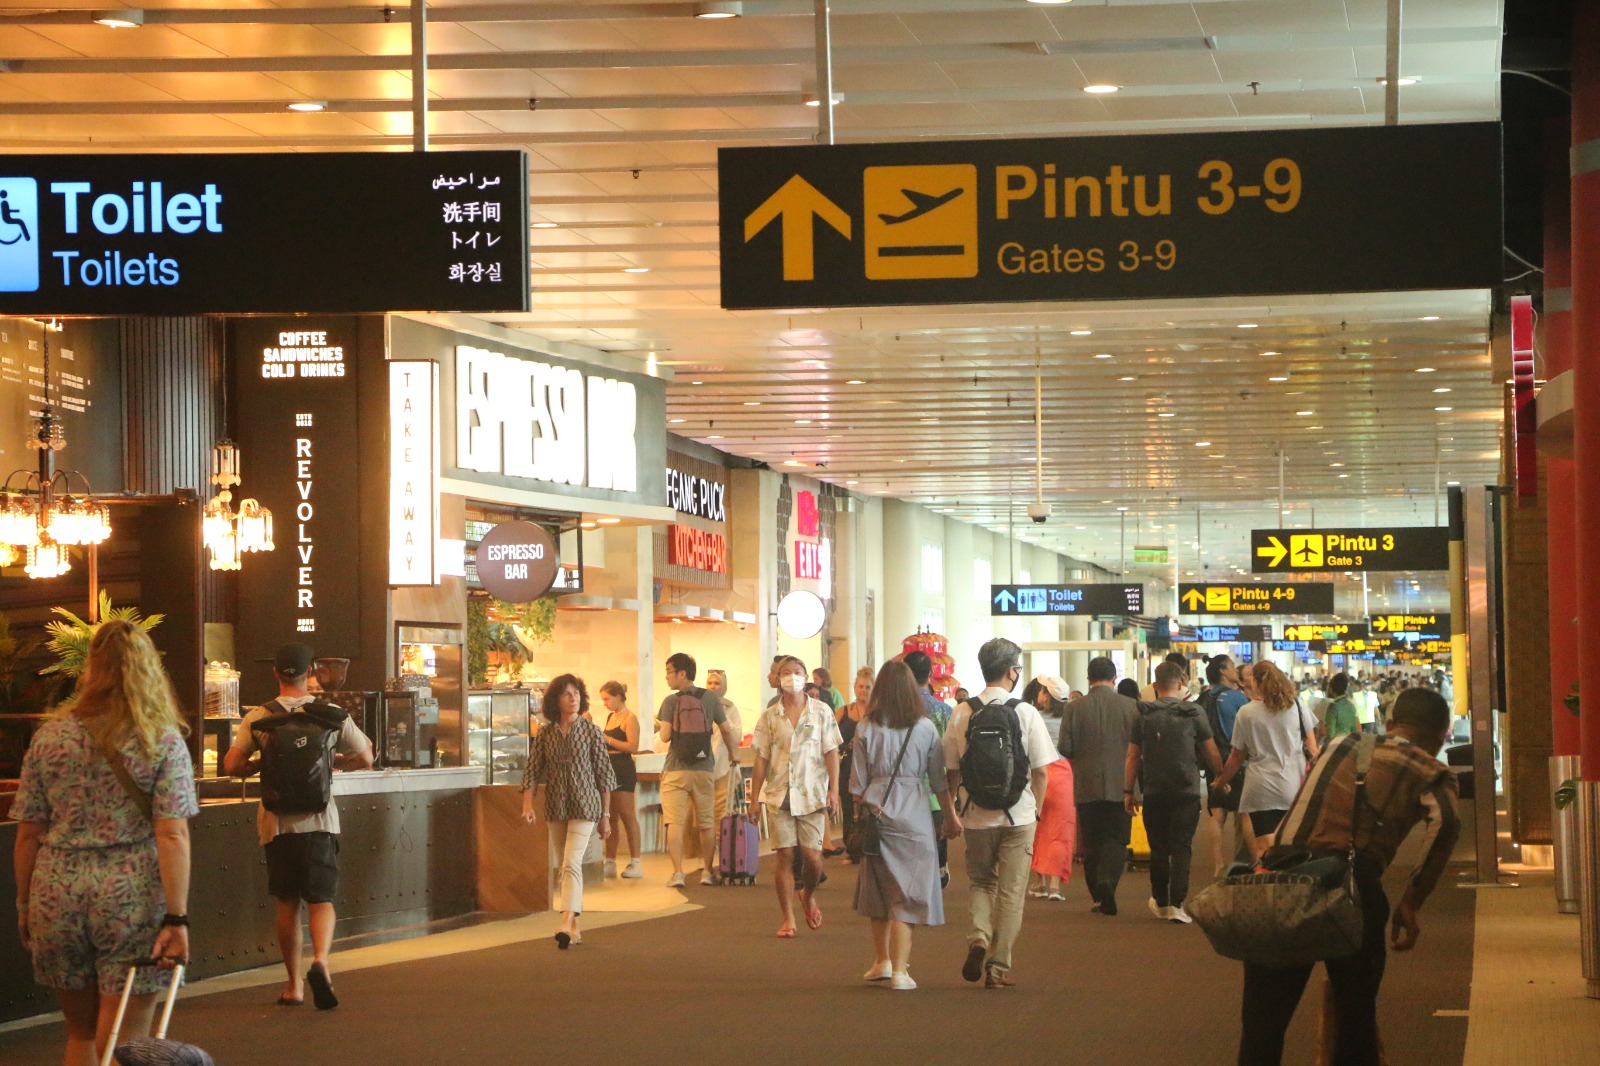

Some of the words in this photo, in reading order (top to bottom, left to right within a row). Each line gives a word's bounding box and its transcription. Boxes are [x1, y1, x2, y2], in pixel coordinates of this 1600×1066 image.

[432, 172, 501, 190] مراحيض
[996, 163, 1171, 220] Pintu
[1197, 158, 1302, 215] 3-9
[51, 181, 223, 235] Toilet
[442, 201, 501, 223] 洗手间
[451, 231, 502, 249] トイレ
[997, 240, 1105, 276] Gates
[1118, 239, 1177, 272] 3-9
[52, 250, 180, 287] Toilets
[448, 262, 502, 283] 화장실
[279, 331, 327, 346] COFFEE
[263, 347, 343, 362] SANDWICHES
[262, 363, 295, 378] COLD
[300, 362, 345, 377] DRINKS
[403, 372, 412, 463] TAKE
[700, 478, 725, 522] PUCK
[296, 438, 313, 608] REVOLVER
[403, 481, 415, 571] AWAY
[1326, 534, 1377, 551] Pintu
[1382, 534, 1395, 551] 3
[488, 543, 544, 560] ESPRESSO
[1327, 556, 1352, 566] Gate
[1355, 556, 1362, 566] 3
[504, 564, 528, 579] BAR
[1049, 589, 1083, 601] Toilet
[1232, 587, 1270, 600] Pintu
[1272, 587, 1296, 600] 4-9
[1050, 603, 1075, 611] Toilets
[1232, 602, 1256, 611] Gates
[1257, 602, 1270, 611] 4-9
[1404, 615, 1428, 625] Pintu
[1429, 615, 1436, 624] 4
[1220, 627, 1240, 635] Toilet
